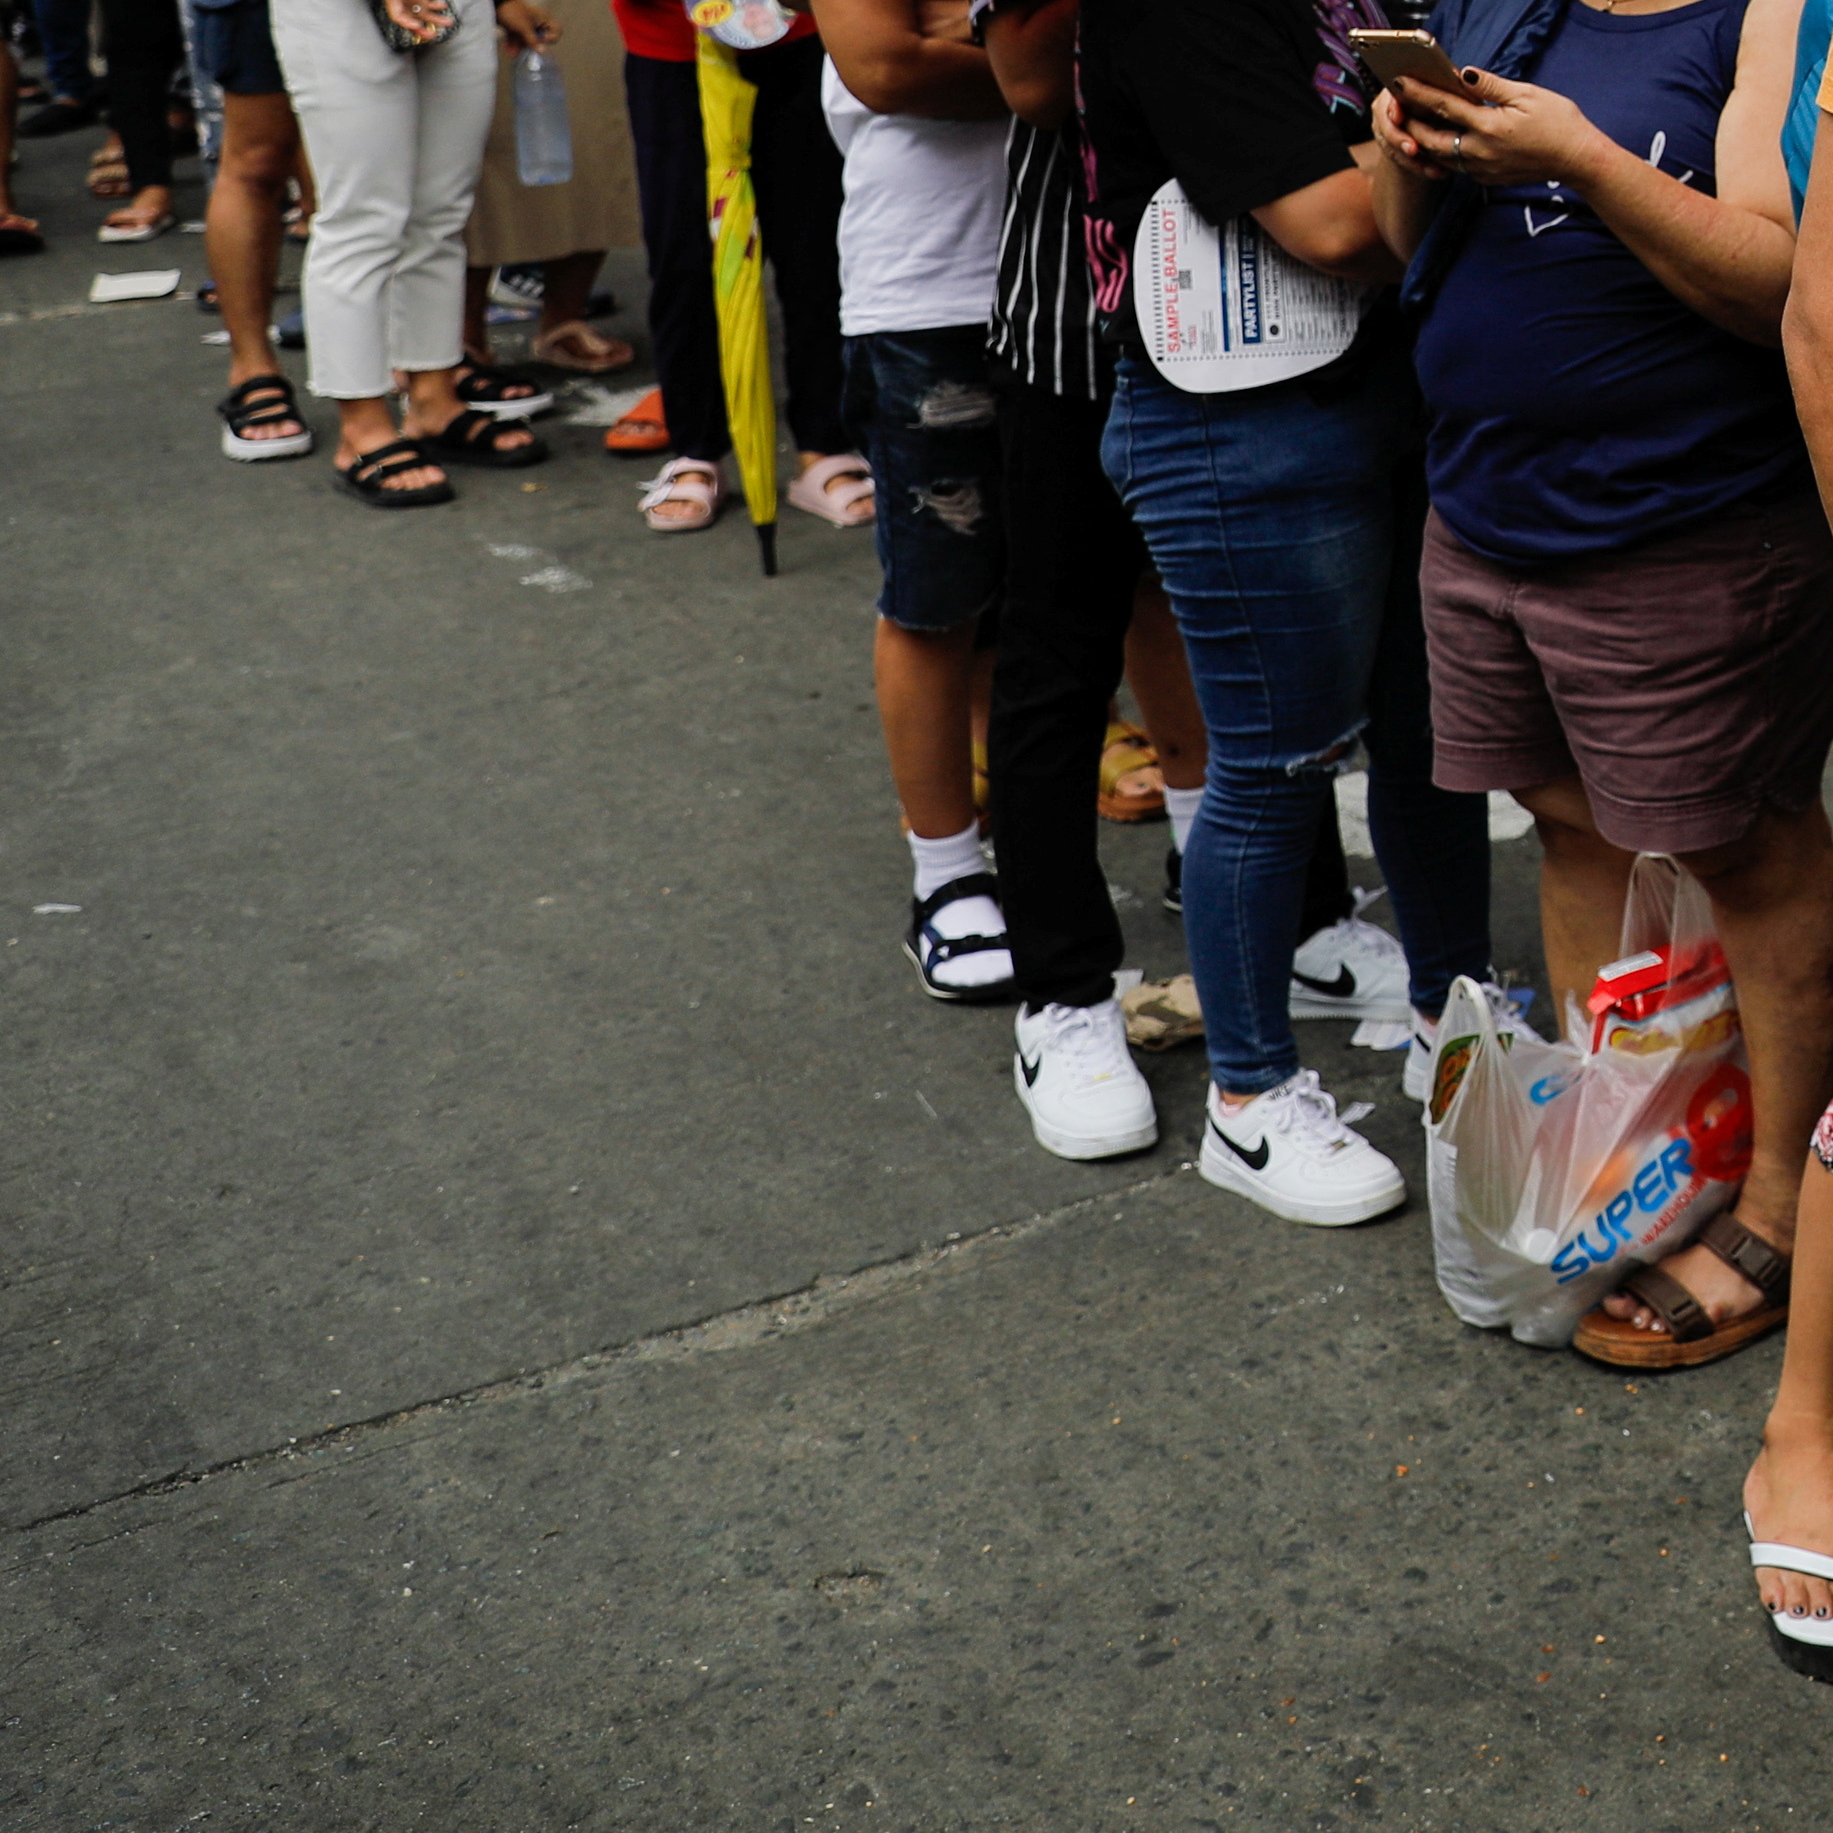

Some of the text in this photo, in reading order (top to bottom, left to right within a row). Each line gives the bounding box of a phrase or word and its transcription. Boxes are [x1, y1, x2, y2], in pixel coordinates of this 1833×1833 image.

[1161, 207, 1183, 354] SAMPLE BALLOT
[1240, 261, 1258, 339] PARTYLIST
[1550, 1137, 1697, 1285] SUPER
